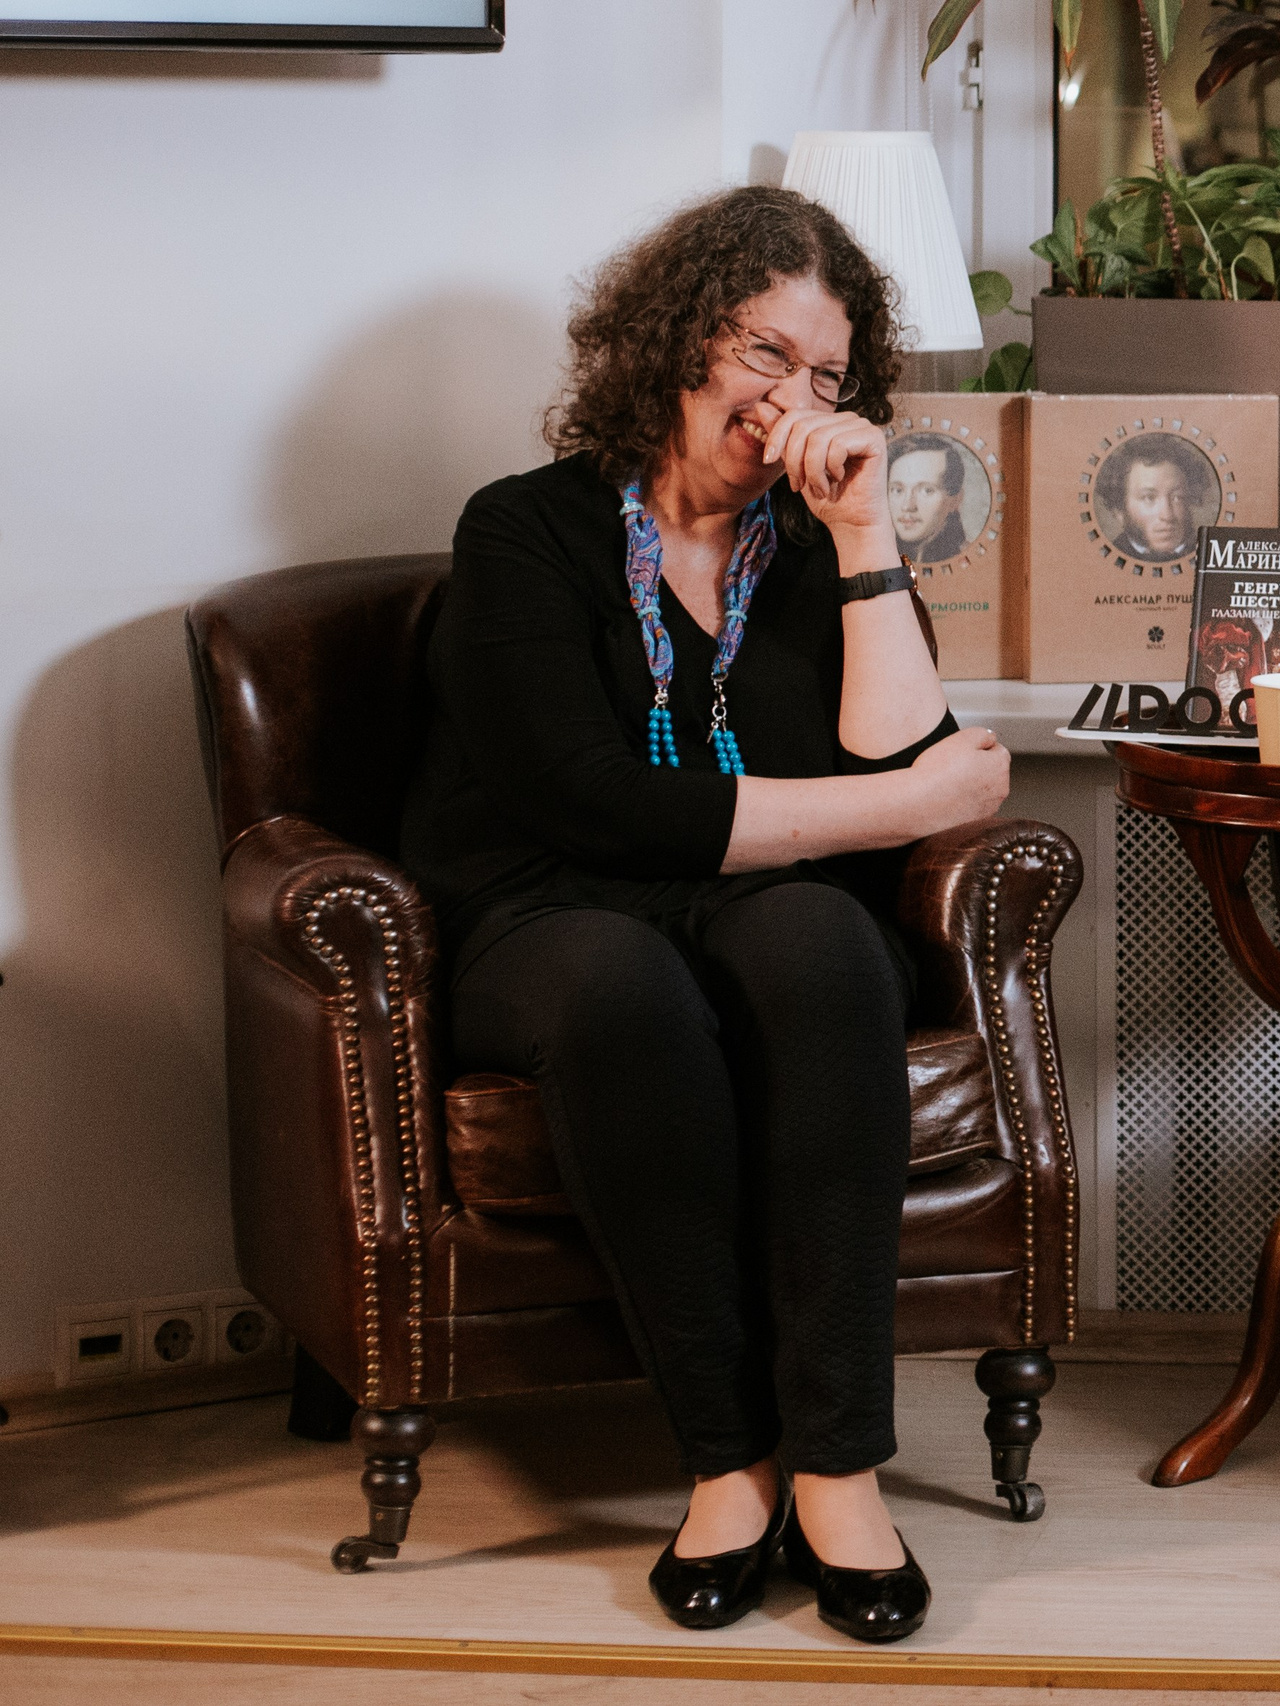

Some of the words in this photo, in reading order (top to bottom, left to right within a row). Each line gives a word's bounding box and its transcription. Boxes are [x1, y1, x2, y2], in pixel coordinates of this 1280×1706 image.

[1094, 595, 1162, 605] АЛЕКСАНДР
[1166, 594, 1193, 603] ПУШ
[926, 602, 989, 611] ЕРМОНТОВ
[1211, 608, 1259, 618] ГЛАЗАМИ
